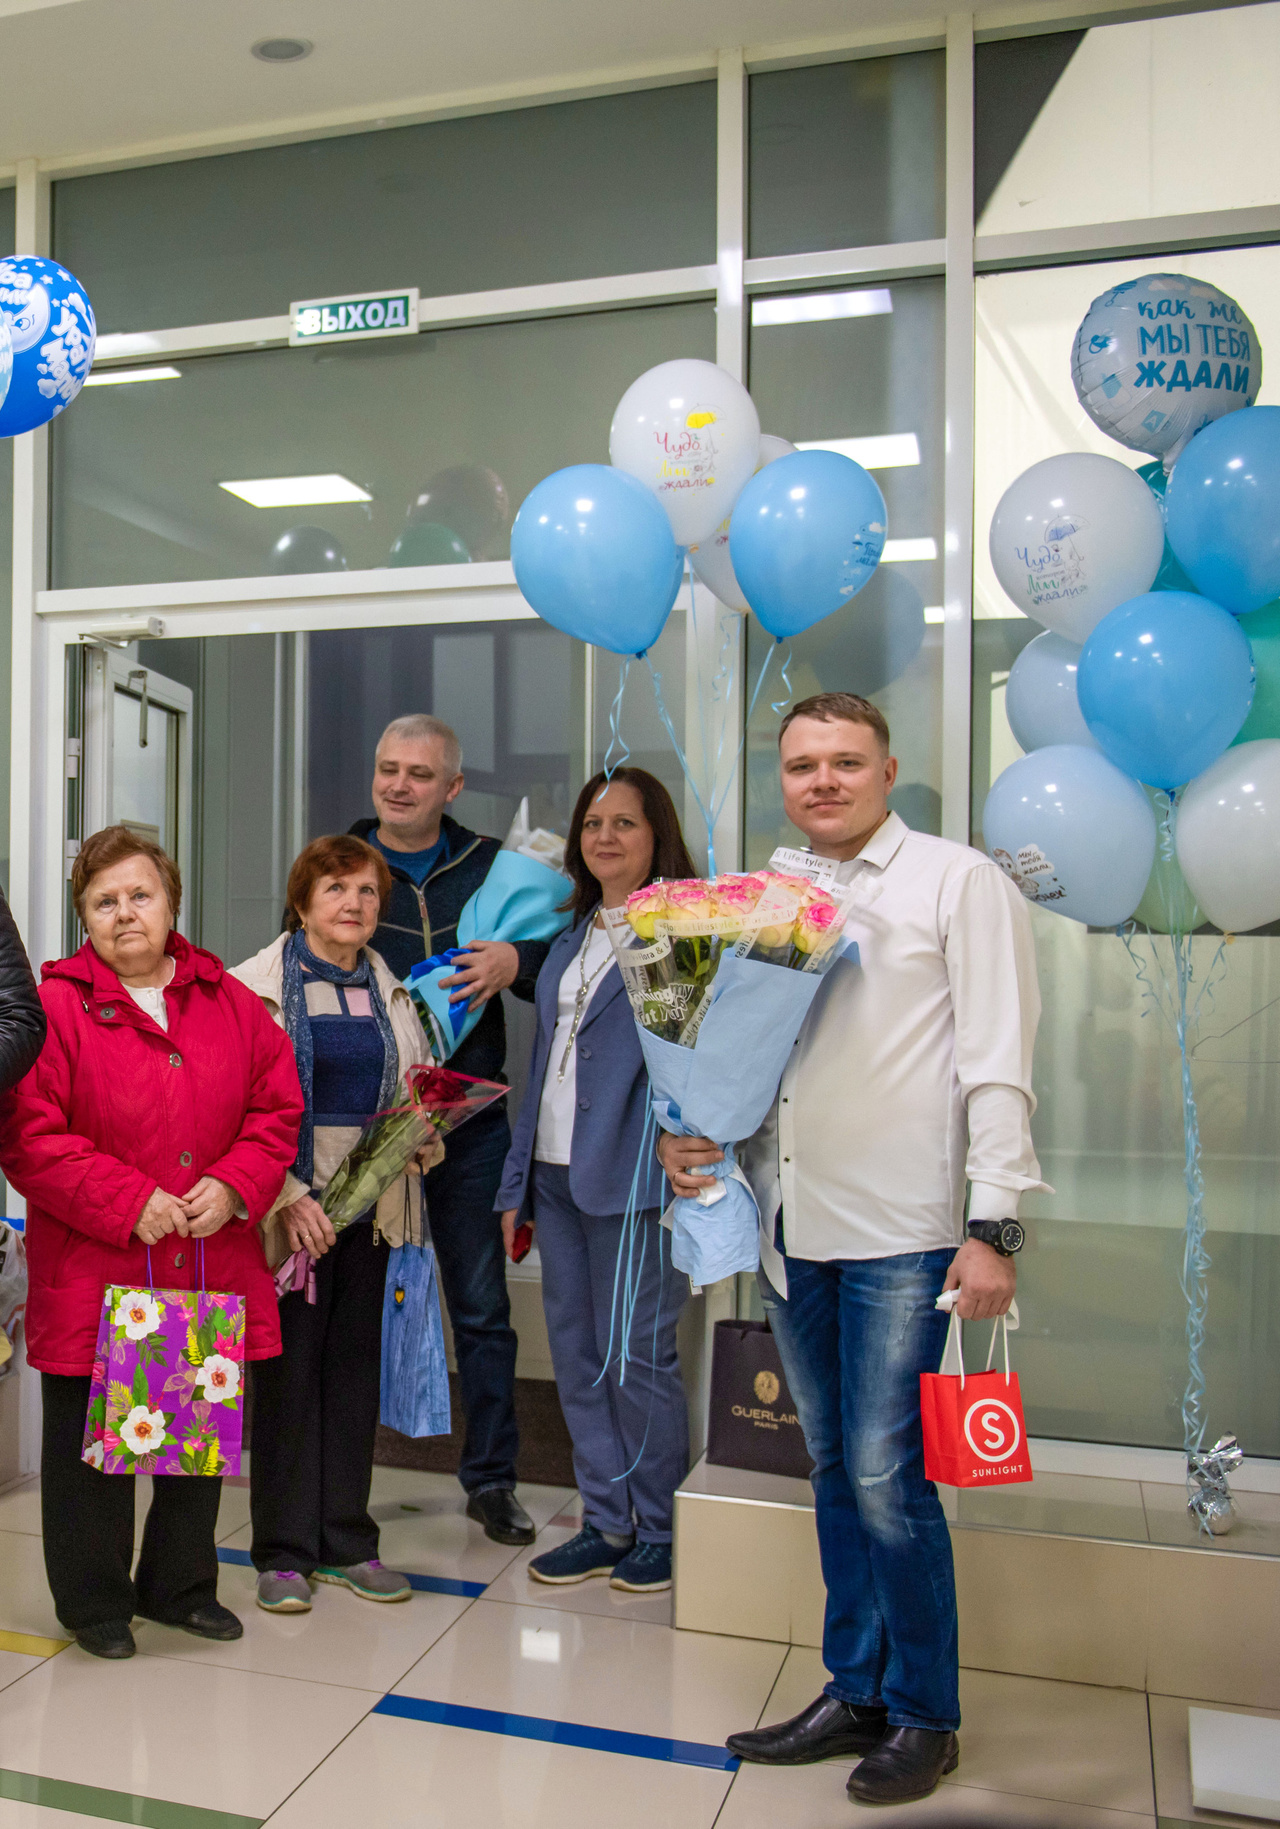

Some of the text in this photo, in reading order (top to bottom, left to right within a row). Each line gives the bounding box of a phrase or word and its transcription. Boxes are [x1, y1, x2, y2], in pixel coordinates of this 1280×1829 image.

[300, 300, 406, 335] ВЫХОД
[1137, 299, 1242, 325] как же
[1137, 323, 1251, 362] МЫ ТЕБЯ
[1133, 360, 1250, 394] ЖДАЛИ
[653, 431, 701, 460] Чудо
[1015, 545, 1061, 573] Чудо
[972, 1464, 1023, 1478] SUNLIGHT
